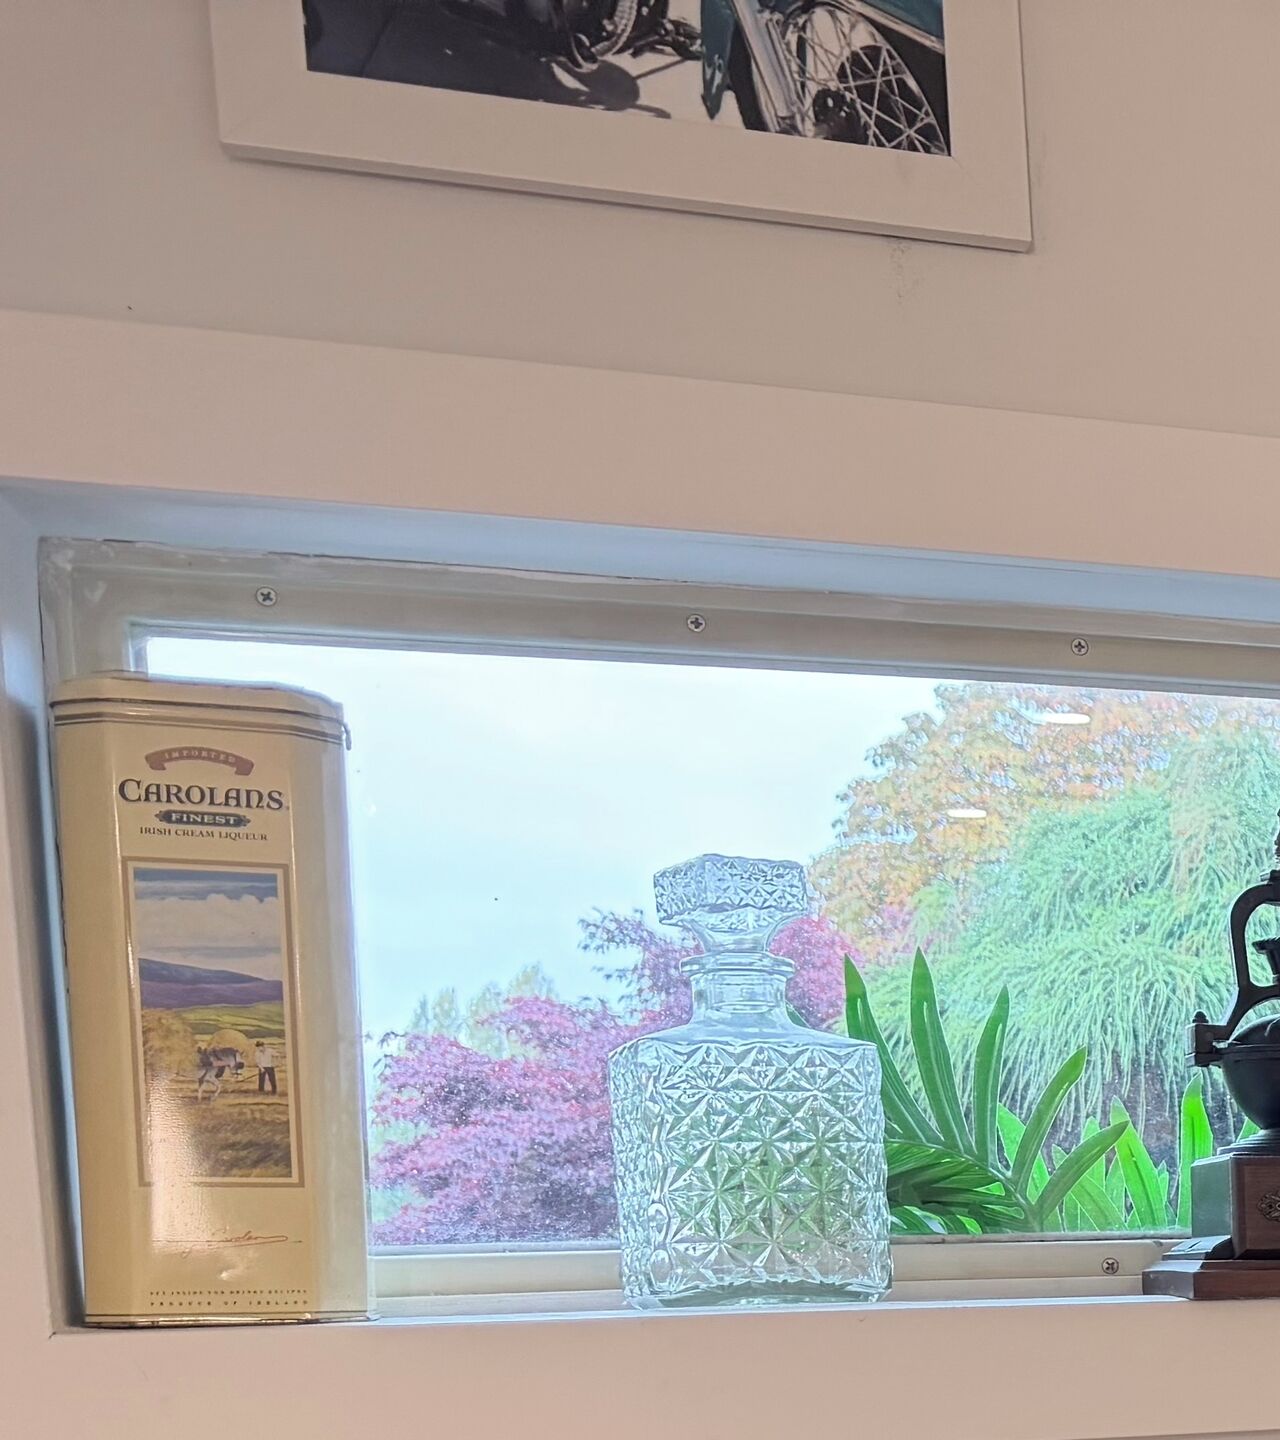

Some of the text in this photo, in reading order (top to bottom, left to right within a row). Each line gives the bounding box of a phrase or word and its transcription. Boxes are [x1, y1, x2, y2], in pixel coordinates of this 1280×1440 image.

[164, 750, 237, 763] IMPORTED
[118, 779, 284, 811] CAROLANS
[171, 812, 239, 825] FINEST
[140, 826, 268, 841] IRISH CREAM LIQUEUR
